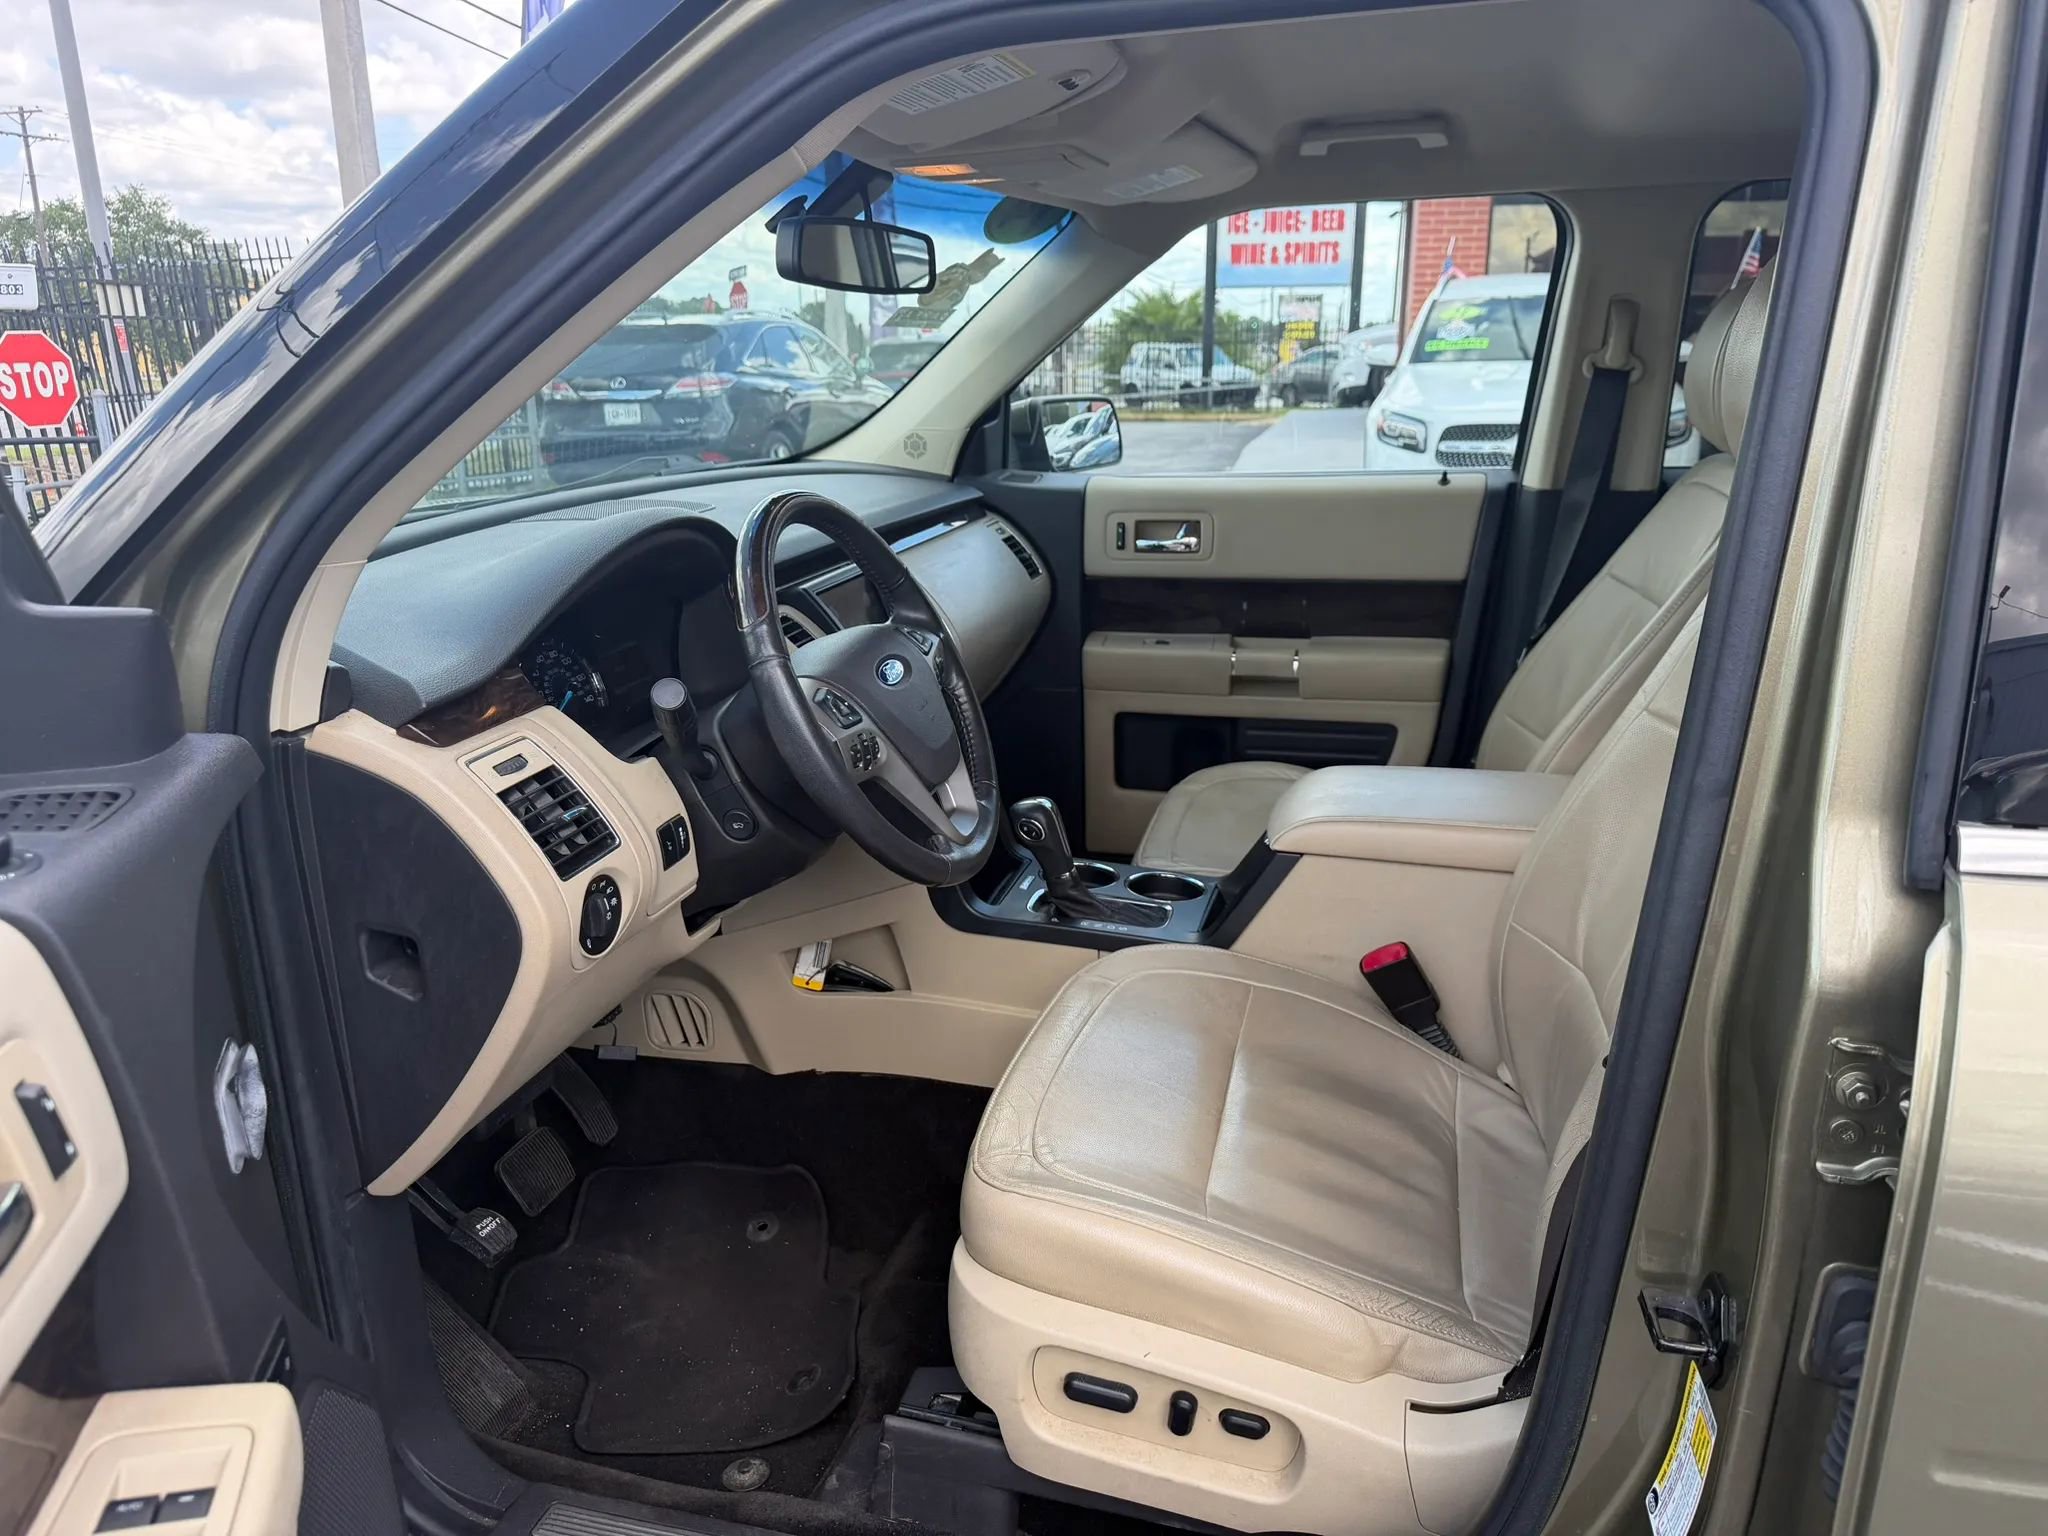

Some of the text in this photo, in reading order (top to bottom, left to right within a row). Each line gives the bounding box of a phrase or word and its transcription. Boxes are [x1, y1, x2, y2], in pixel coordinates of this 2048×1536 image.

[1228, 211, 1249, 234] ICE
[1311, 209, 1345, 231] BEER
[1231, 241, 1339, 265] WINE & SPIRITS
[0, 361, 69, 399] STOP
[475, 1216, 494, 1230] PUSH
